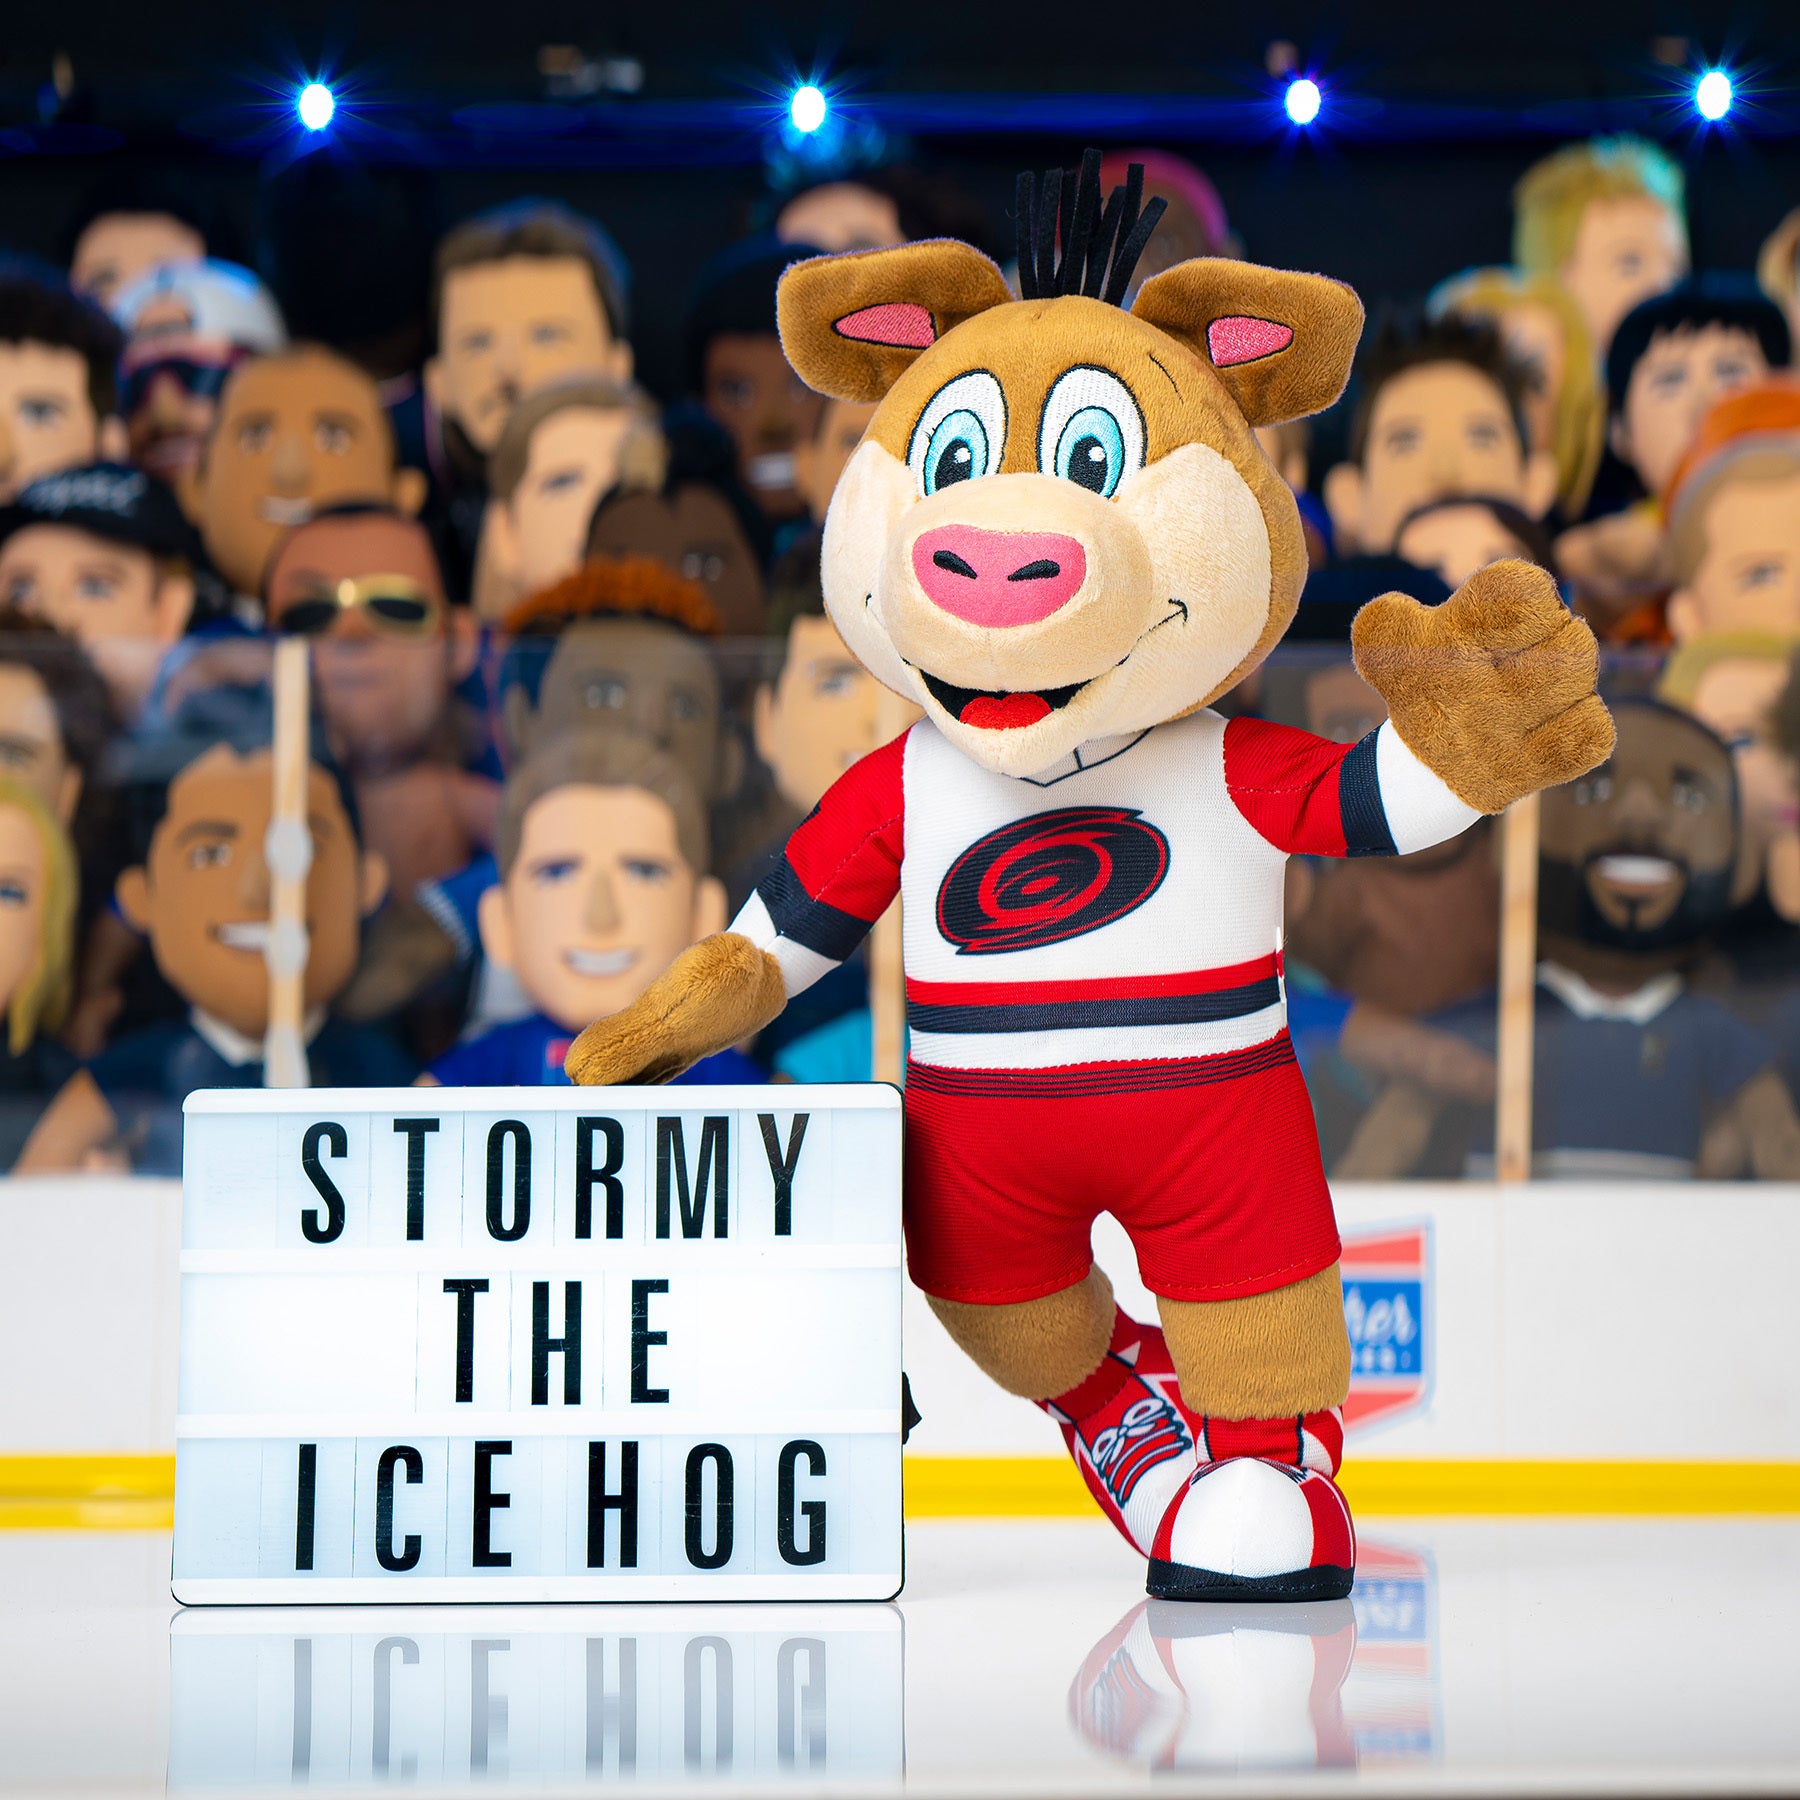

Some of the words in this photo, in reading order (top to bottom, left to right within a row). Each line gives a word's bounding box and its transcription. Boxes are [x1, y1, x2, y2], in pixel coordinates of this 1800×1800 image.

[301, 1113, 810, 1244] STORMY
[442, 1278, 670, 1406] THE
[295, 1440, 513, 1572] ICE
[586, 1439, 827, 1570] HOG
